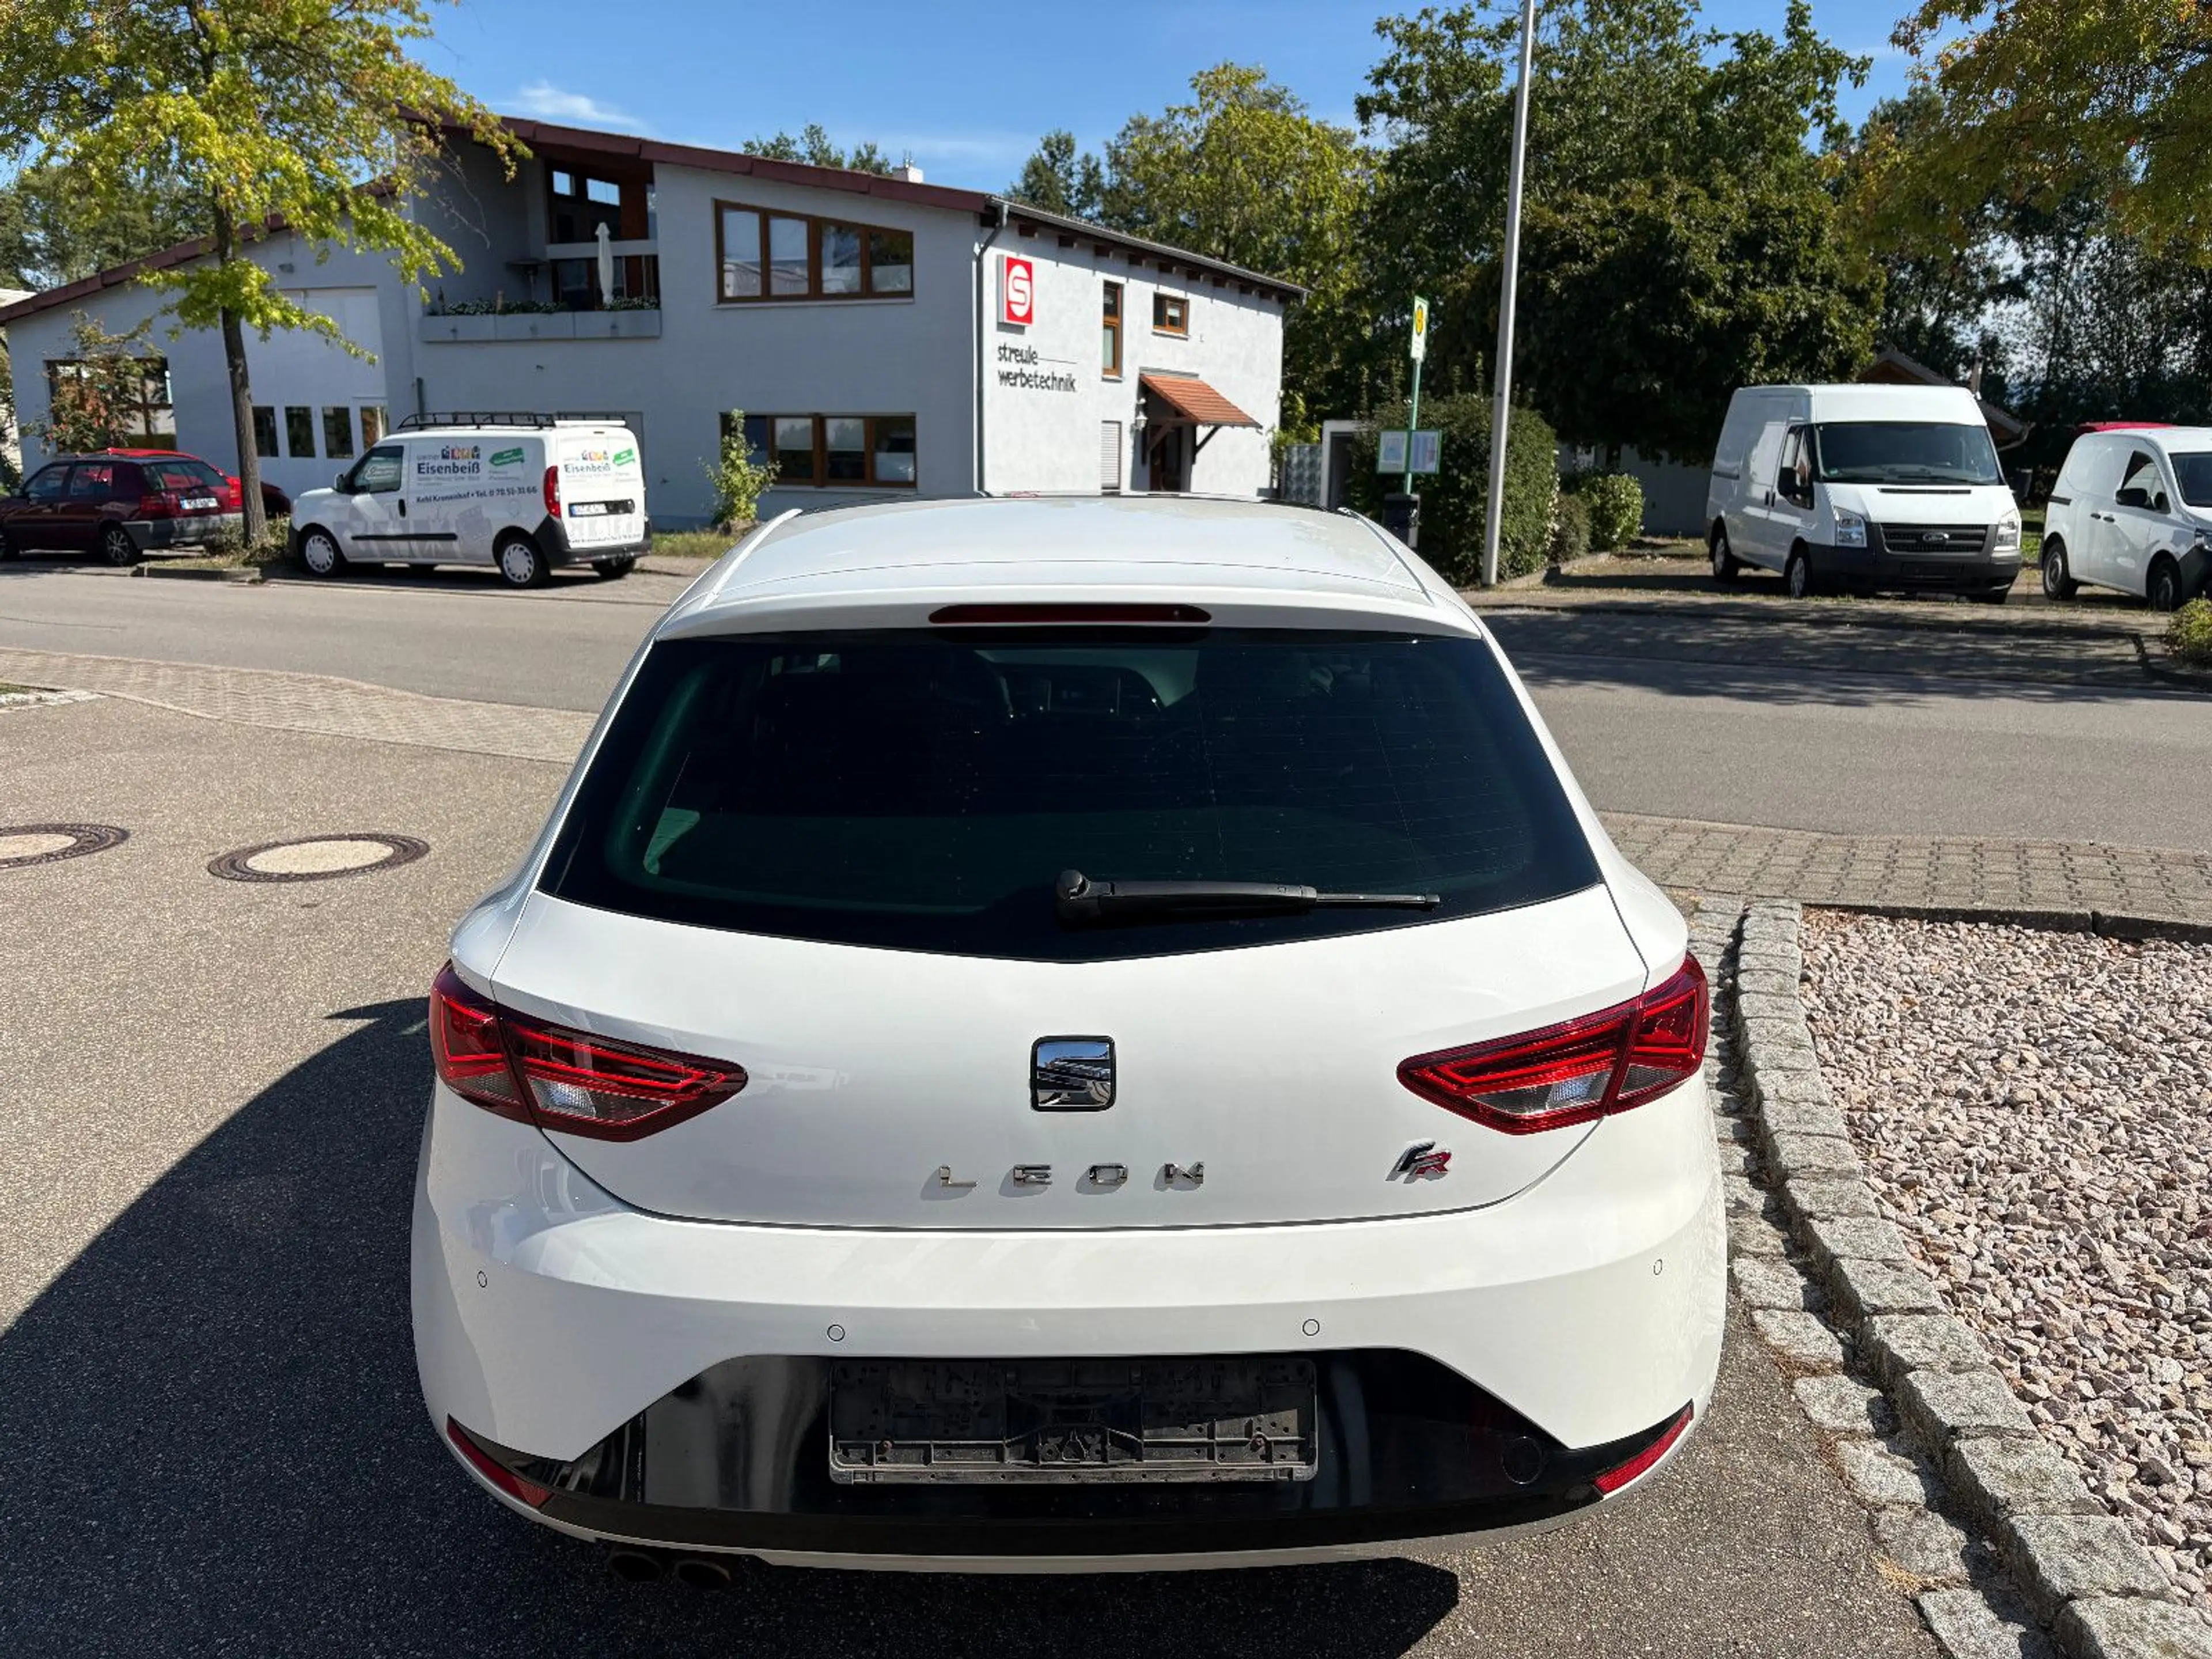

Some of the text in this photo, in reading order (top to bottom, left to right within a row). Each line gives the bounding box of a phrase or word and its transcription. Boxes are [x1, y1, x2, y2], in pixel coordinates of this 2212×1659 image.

[998, 342, 1039, 365] streule
[998, 369, 1077, 392] werbetechnik
[417, 462, 480, 474] Eisenbeiß
[564, 463, 611, 474] Eisenbeiß
[416, 495, 431, 503] Kehl
[1391, 1138, 1452, 1179] FR
[938, 1161, 1205, 1188] LEON
